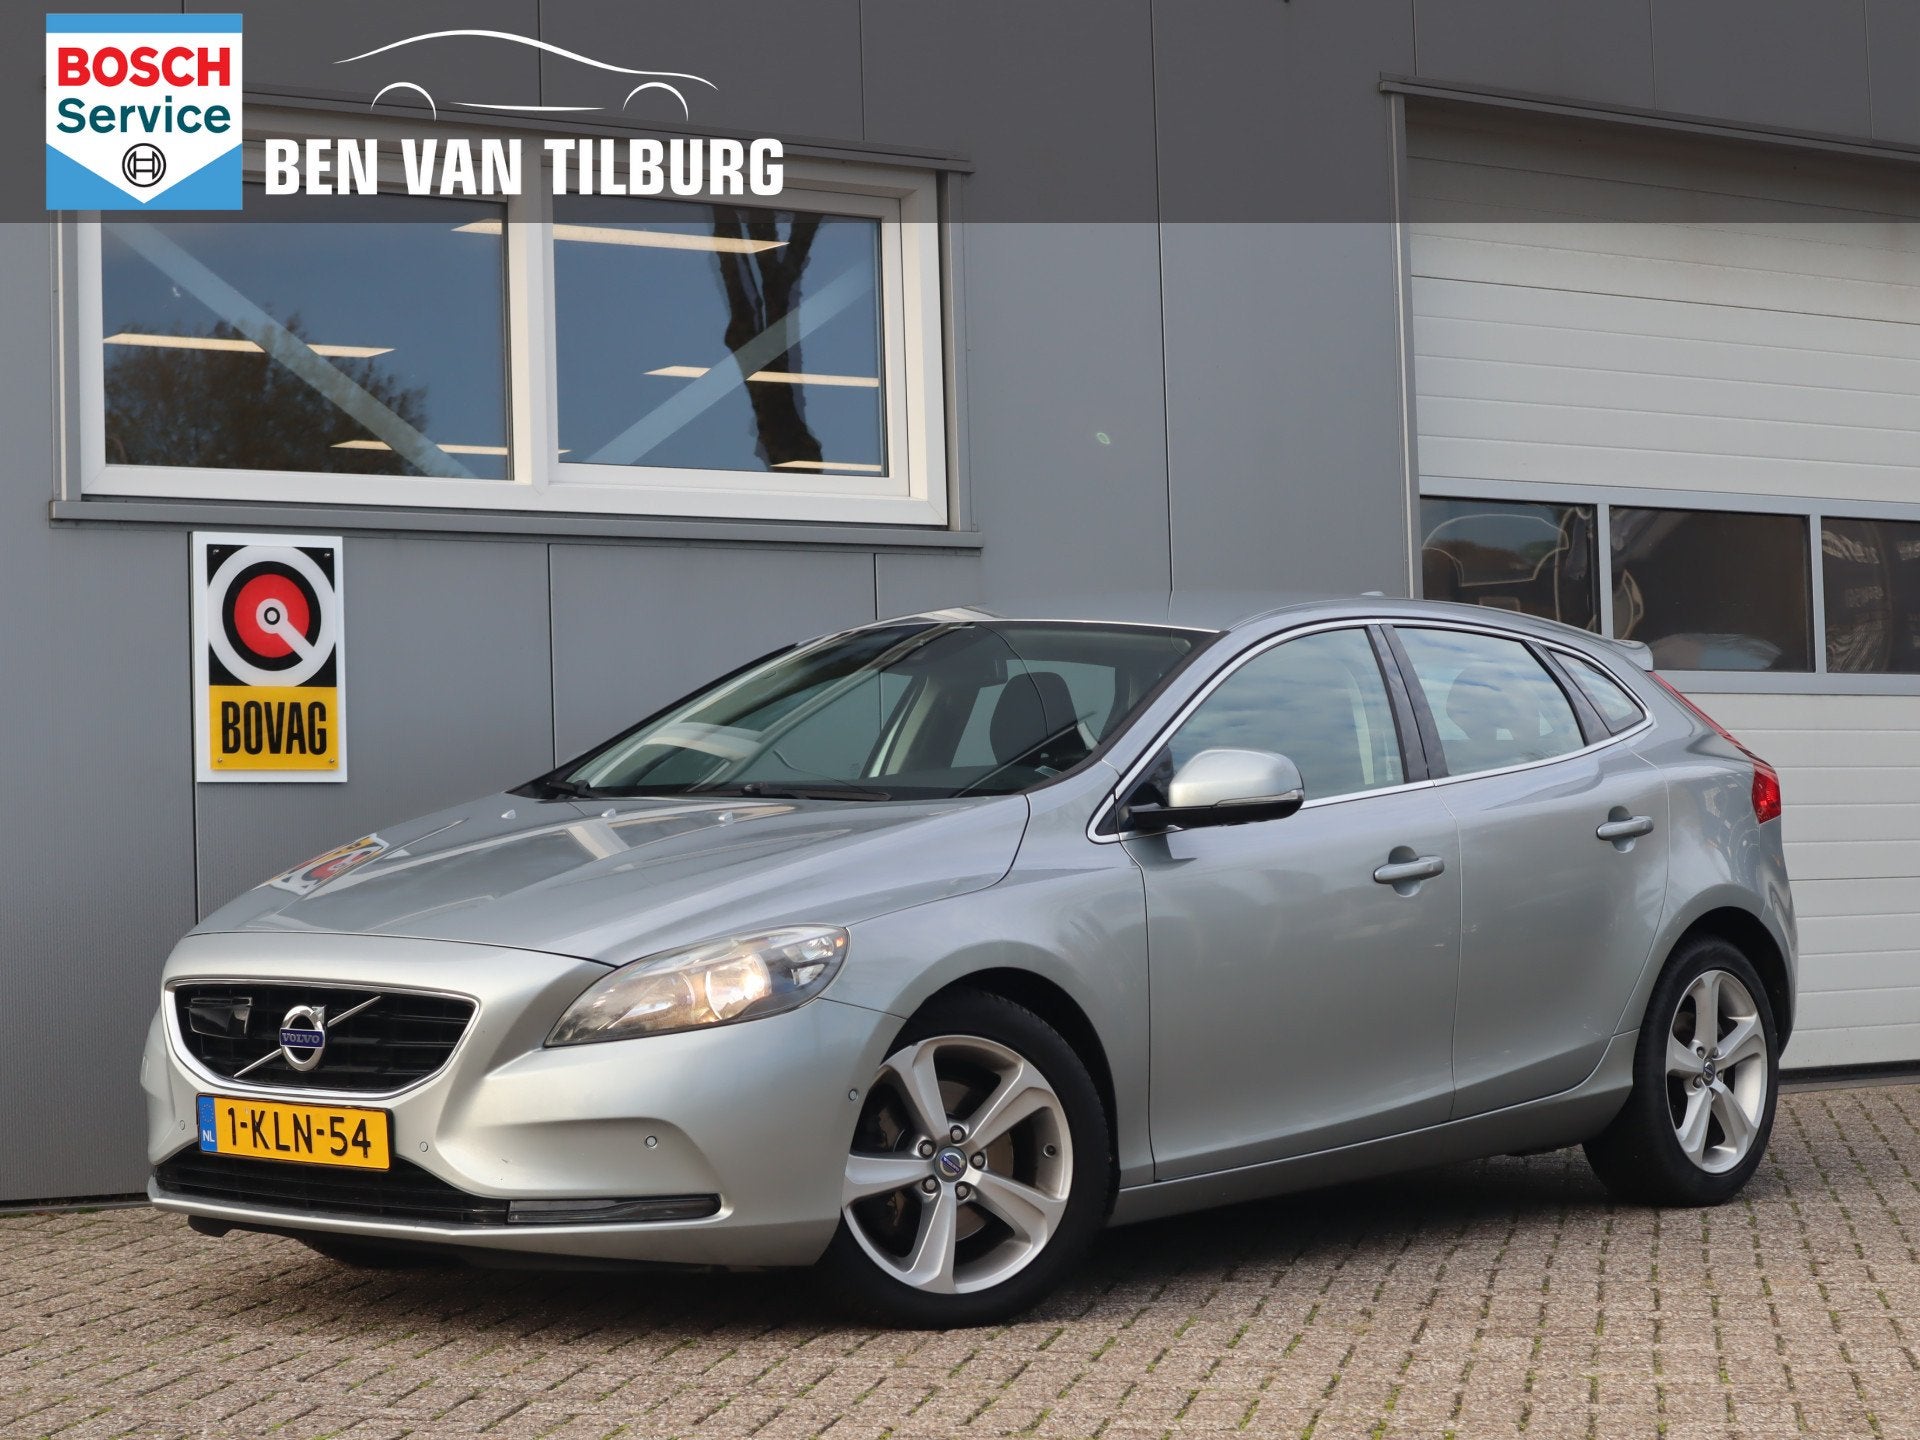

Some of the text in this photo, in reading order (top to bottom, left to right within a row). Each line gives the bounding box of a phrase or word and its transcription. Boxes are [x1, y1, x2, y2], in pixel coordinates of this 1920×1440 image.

[222, 701, 326, 755] BOVAG
[282, 1032, 320, 1044] VOLVO
[202, 1130, 216, 1143] NL
[228, 1107, 371, 1158] 1-KLN-54
